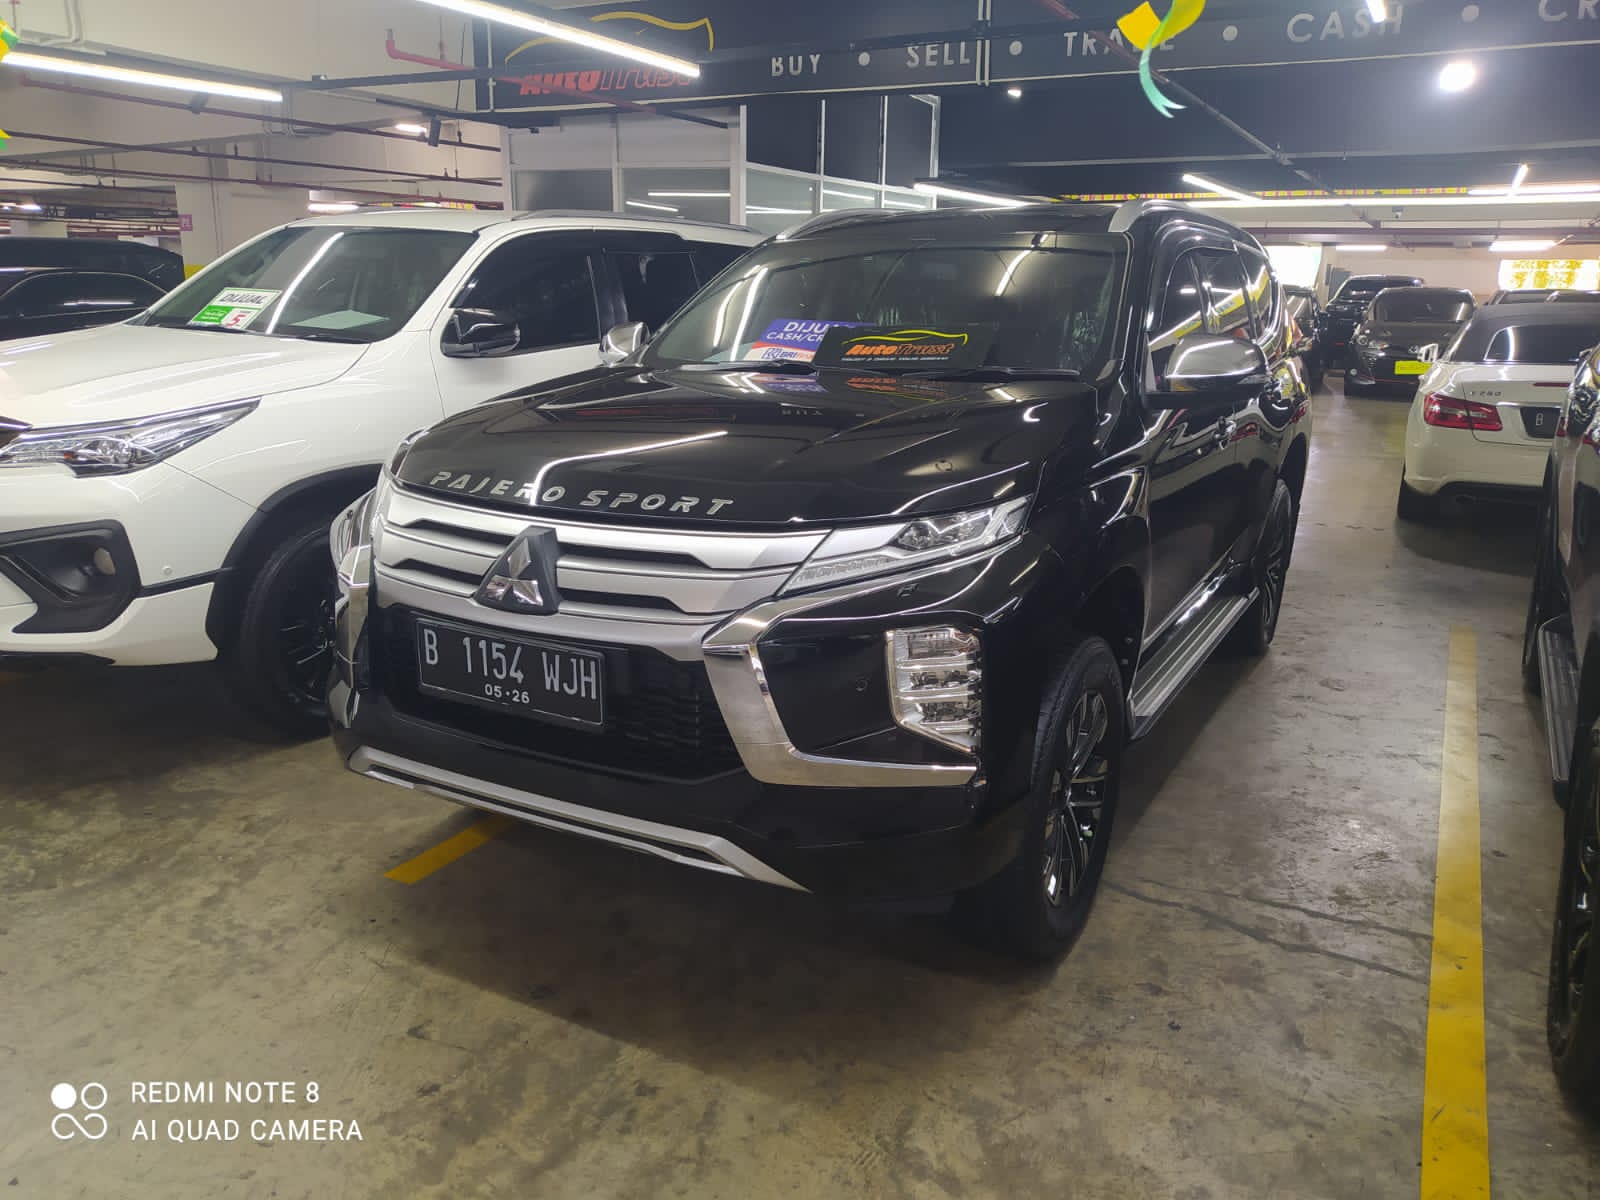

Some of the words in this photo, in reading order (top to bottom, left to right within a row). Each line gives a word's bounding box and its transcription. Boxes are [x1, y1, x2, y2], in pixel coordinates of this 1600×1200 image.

[771, 53, 821, 77] BUY
[905, 41, 970, 68] SELL
[1063, 27, 1175, 57] TRA
[1286, 4, 1404, 43] CASH
[226, 313, 247, 327] 5
[783, 321, 847, 334] DIJU
[429, 471, 566, 502] PAJERO
[579, 490, 734, 516] SPORT
[424, 629, 438, 665] B
[463, 637, 524, 684] 1154
[542, 651, 597, 700] WJH
